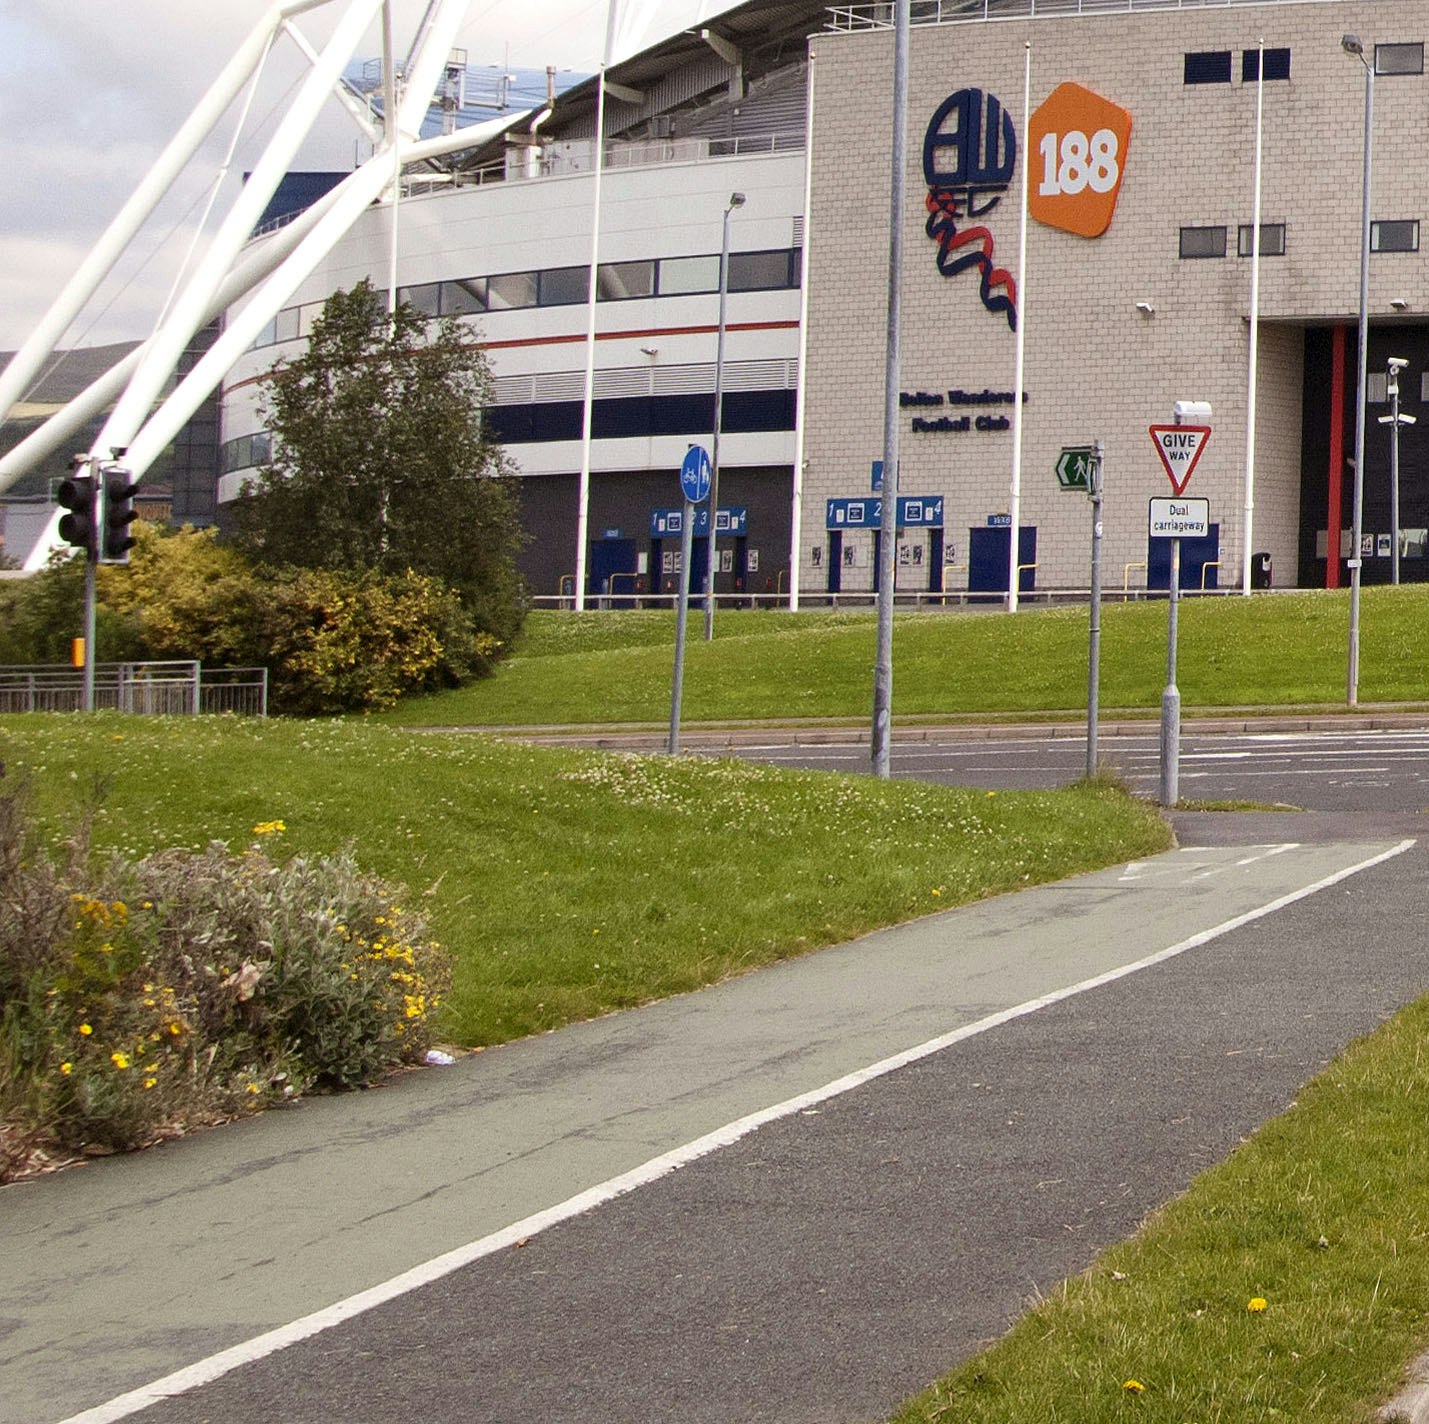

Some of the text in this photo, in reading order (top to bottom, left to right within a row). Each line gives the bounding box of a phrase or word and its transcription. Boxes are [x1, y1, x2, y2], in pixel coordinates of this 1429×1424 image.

[1039, 128, 1119, 196] 188
[912, 415, 1010, 432] Football Club
[1163, 434, 1195, 447] GIVE
[1169, 451, 1190, 461] WAY
[829, 503, 834, 517] 1
[873, 502, 882, 516] 2
[934, 500, 942, 514] 4
[1169, 504, 1189, 516] Dual
[652, 513, 658, 526] 1
[701, 511, 707, 525] 3
[739, 510, 746, 524] 4
[1154, 519, 1205, 532] carriageway
